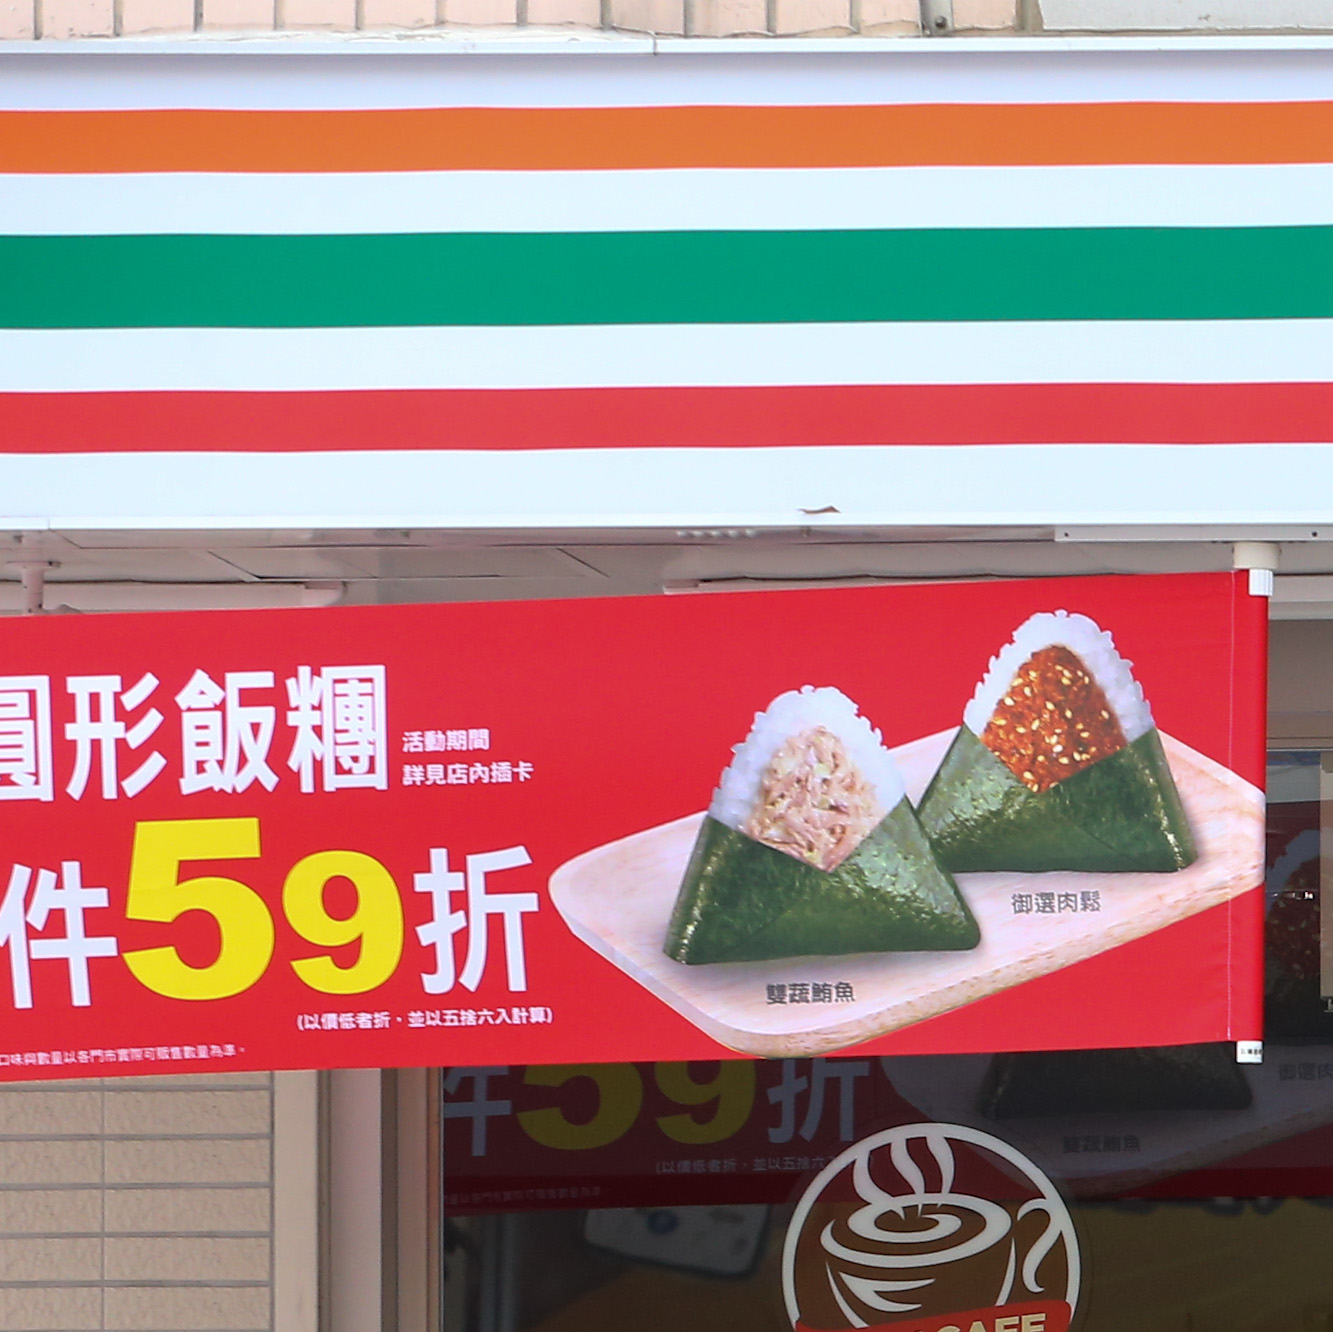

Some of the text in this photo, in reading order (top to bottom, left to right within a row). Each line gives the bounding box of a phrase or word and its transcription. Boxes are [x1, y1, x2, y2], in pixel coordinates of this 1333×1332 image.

[401, 728, 491, 755] 活動期間
[401, 761, 534, 787] 詳見店內插卡
[765, 981, 856, 1006] 雙蔬鮪魚
